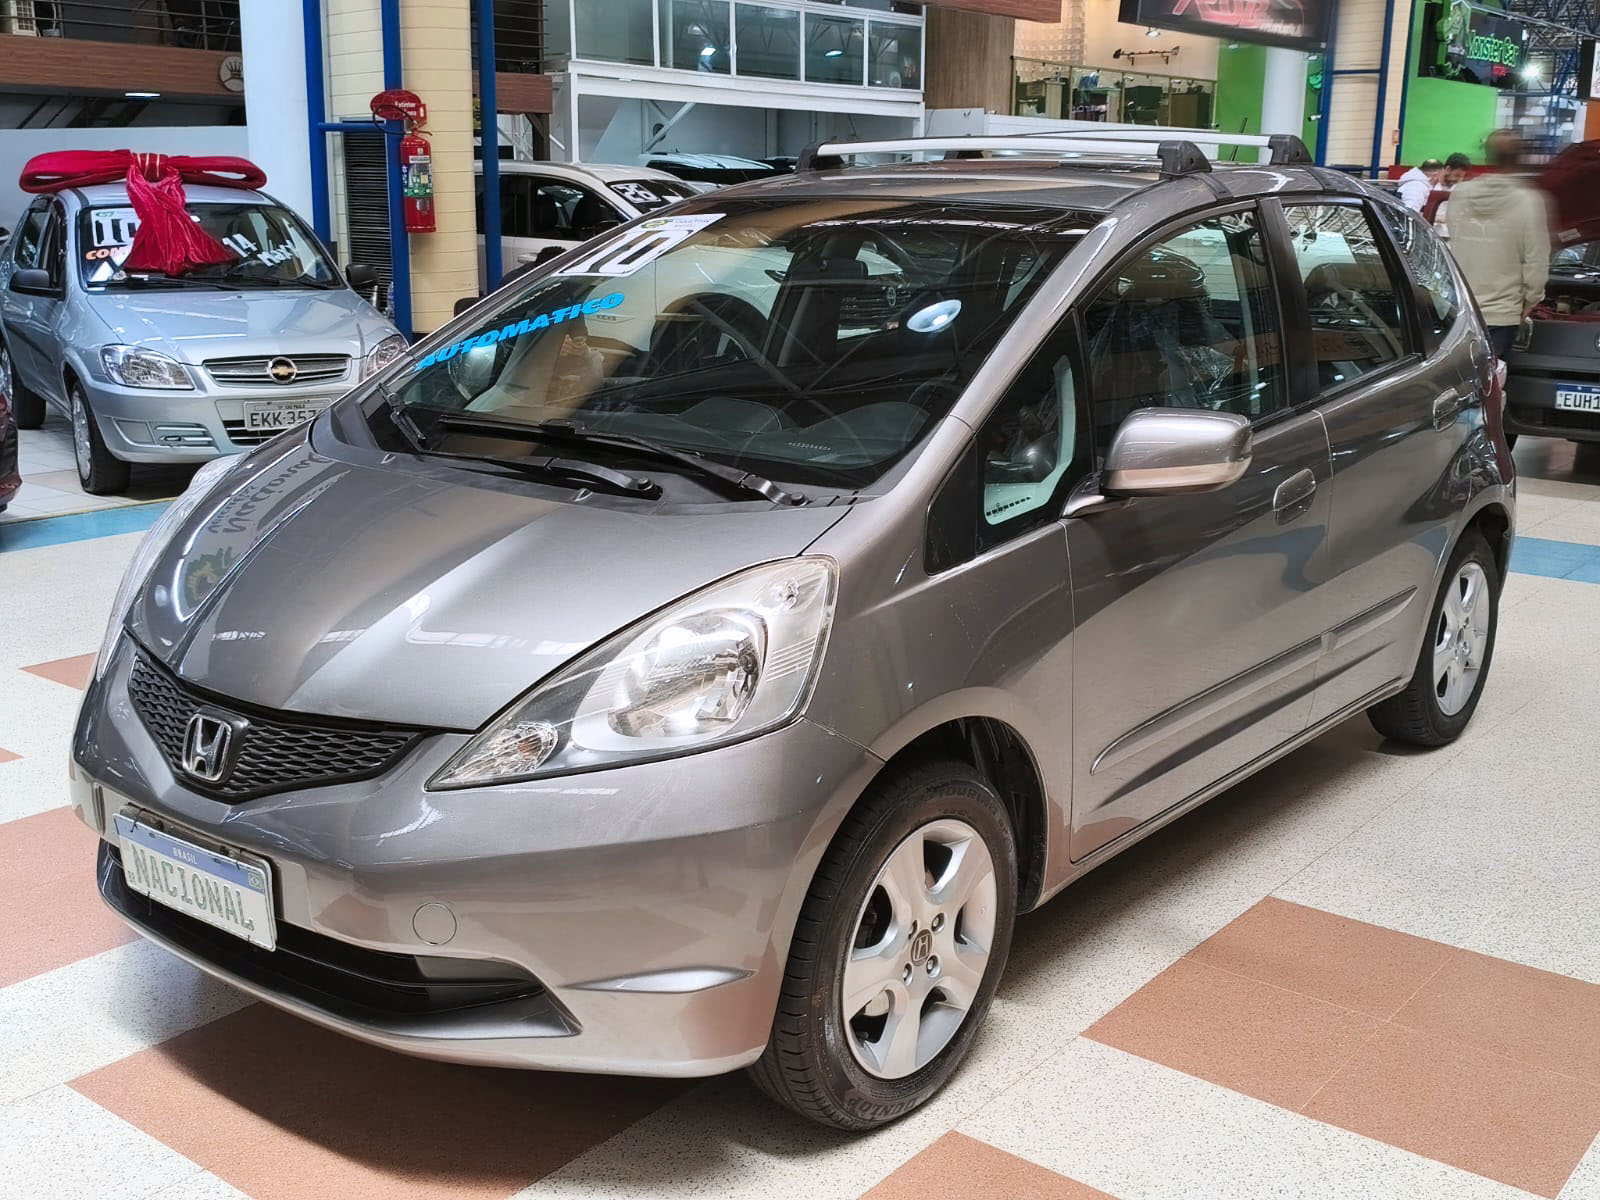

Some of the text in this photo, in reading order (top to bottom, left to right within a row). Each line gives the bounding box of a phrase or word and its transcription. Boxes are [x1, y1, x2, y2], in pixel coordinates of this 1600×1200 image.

[562, 229, 693, 274] 10
[414, 292, 625, 372] AUTOMATICO
[131, 844, 254, 931] NACIONAL
